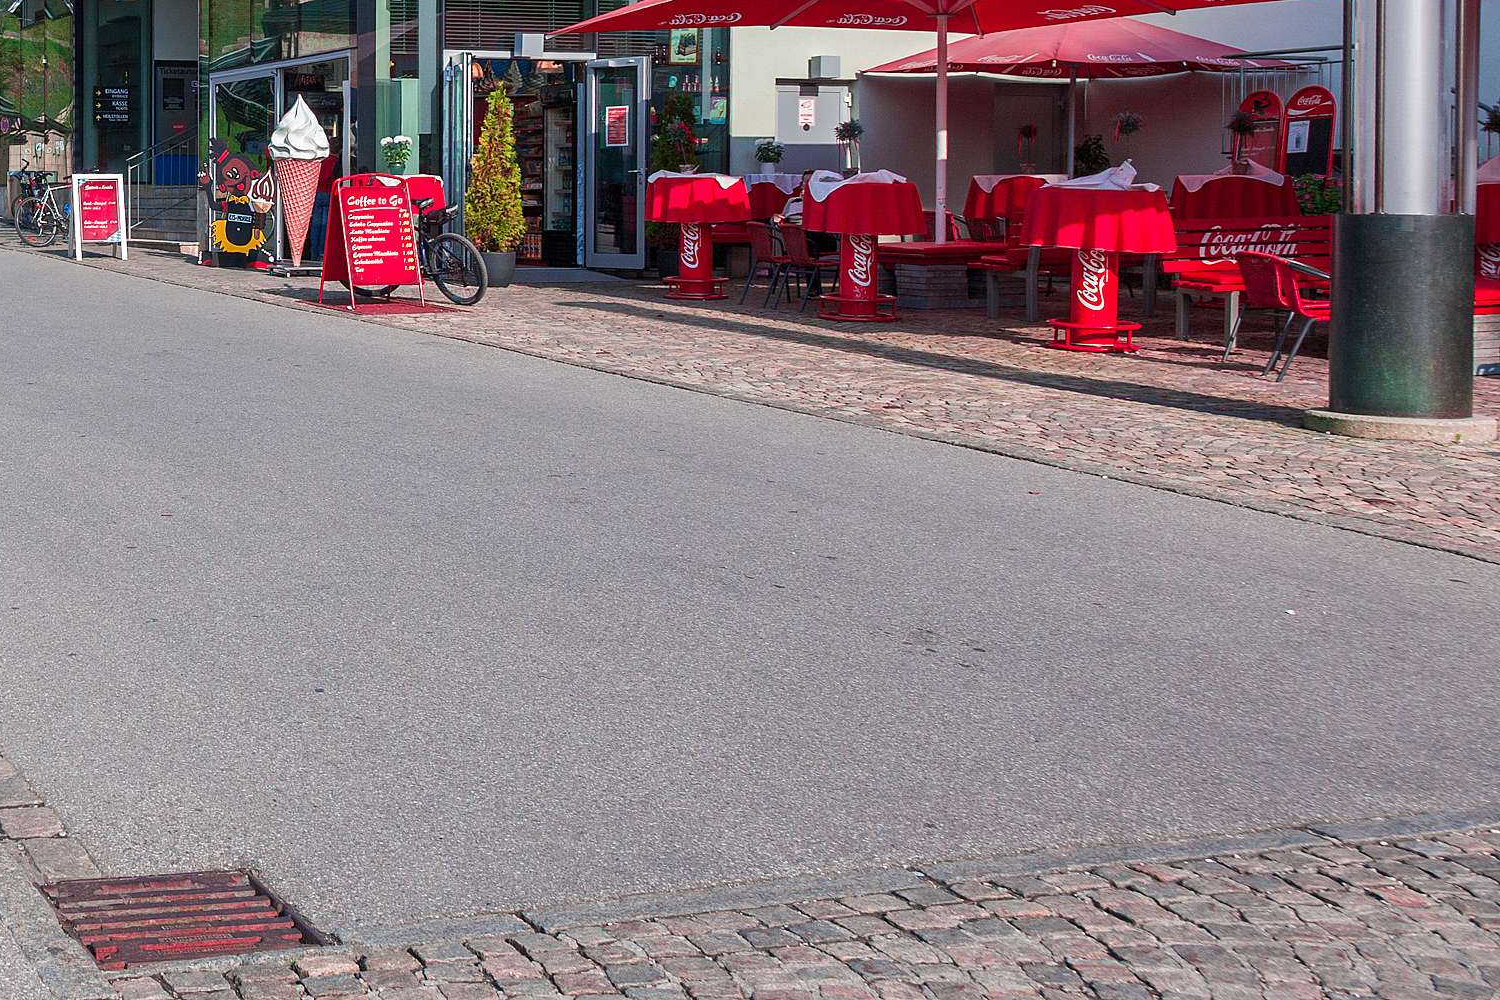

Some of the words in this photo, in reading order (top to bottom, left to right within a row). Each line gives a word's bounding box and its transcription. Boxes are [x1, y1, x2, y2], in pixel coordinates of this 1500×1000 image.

[347, 195, 376, 207] Coffee
[378, 196, 387, 205] to
[388, 194, 403, 207] Go
[1076, 249, 1106, 311] Coca-Co
